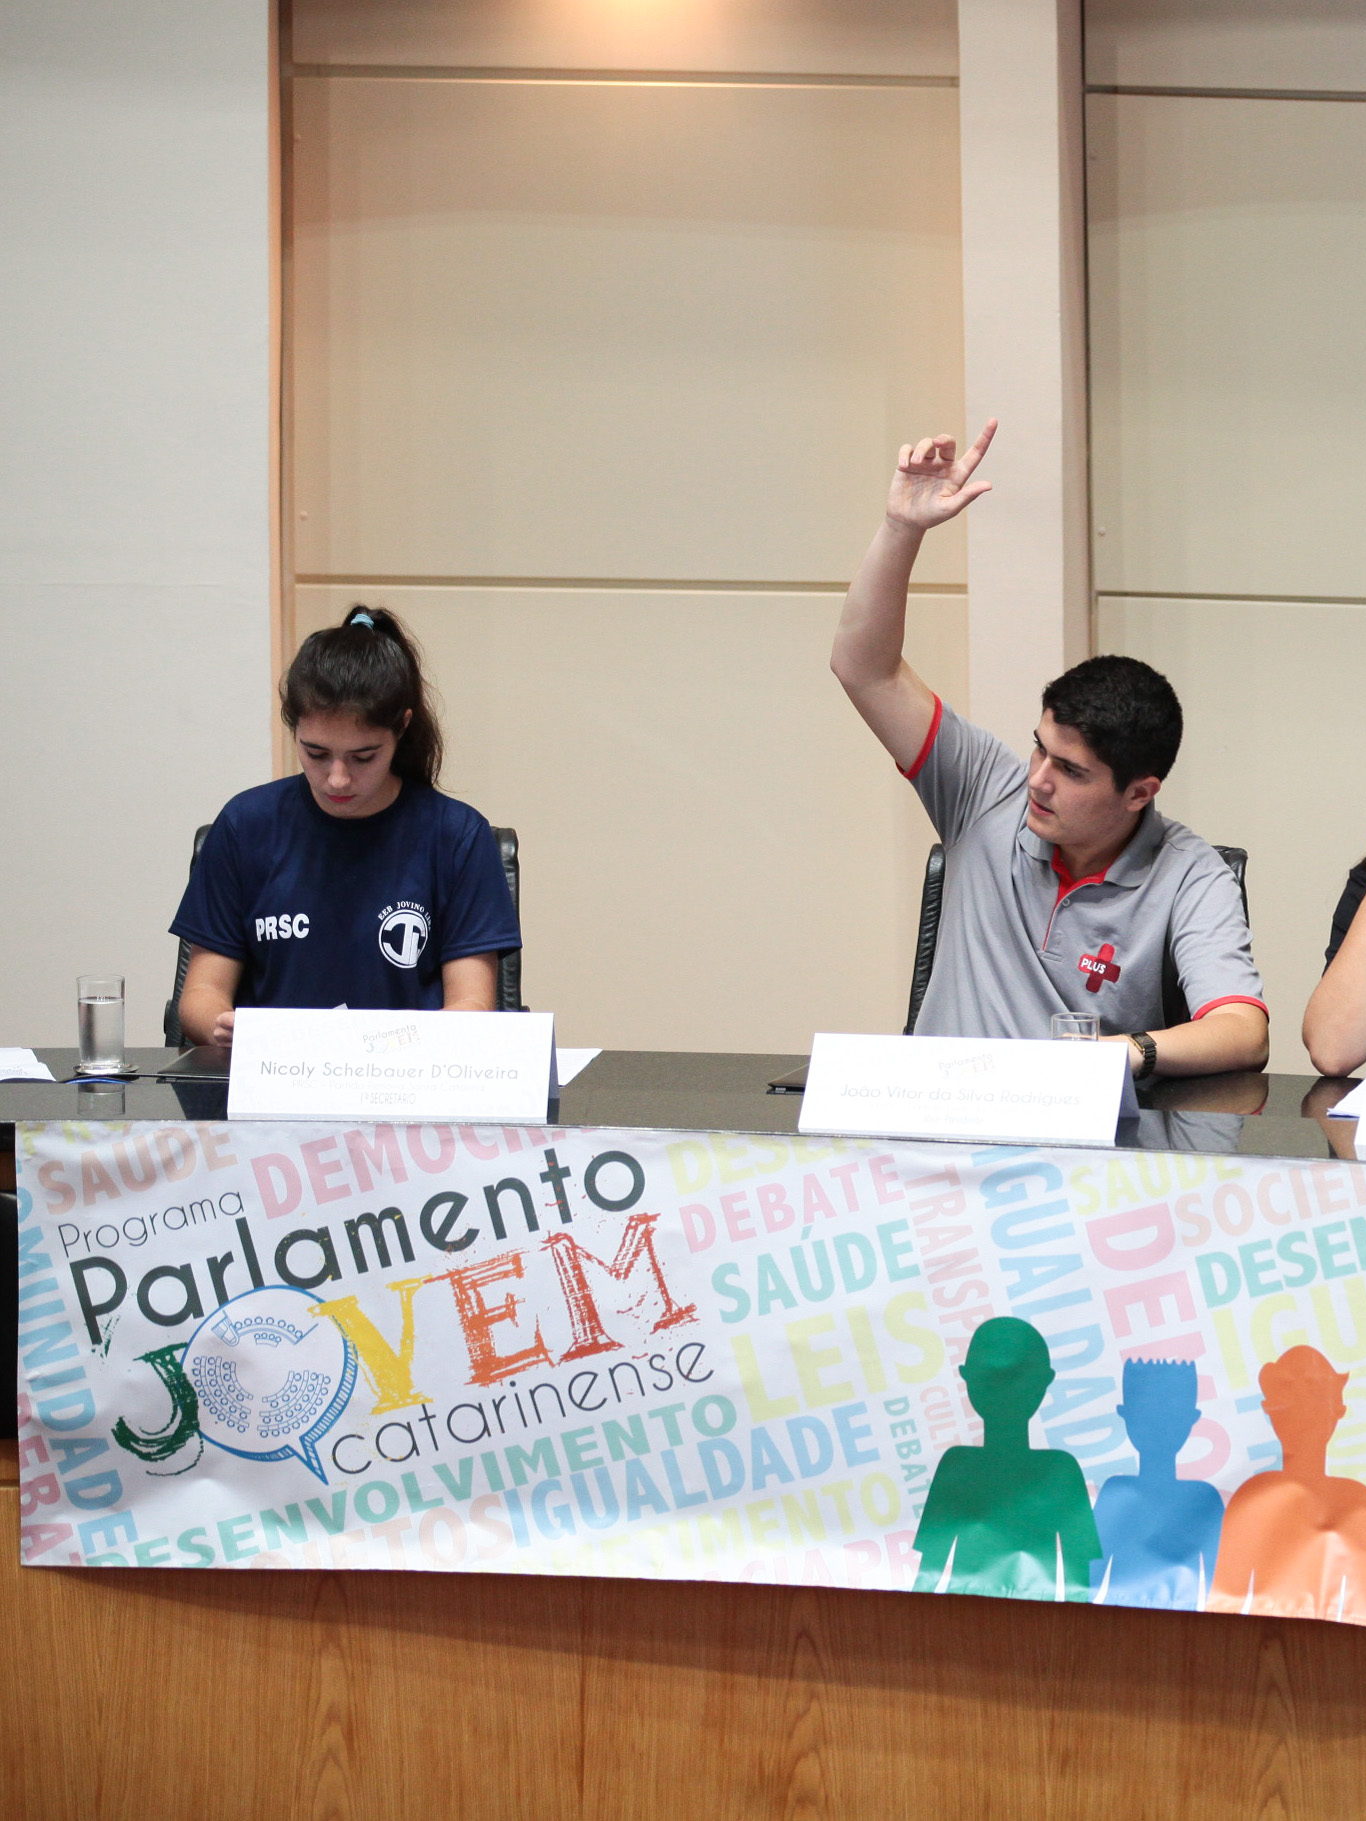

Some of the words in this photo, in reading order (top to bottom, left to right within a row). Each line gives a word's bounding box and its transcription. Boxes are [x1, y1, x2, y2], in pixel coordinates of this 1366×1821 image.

[256, 913, 309, 941] PRSC
[397, 901, 425, 913] JOVINO
[1081, 958, 1106, 974] PLUS
[260, 1060, 315, 1077] Nicoly
[322, 1061, 424, 1079] Schelbauer
[431, 1063, 519, 1080] D'Oliveira
[362, 1024, 417, 1043] Parlamento
[840, 1084, 881, 1098] João
[887, 1086, 923, 1100] Vitor
[929, 1087, 951, 1101] da
[957, 1088, 995, 1102] Silva
[1001, 1090, 1080, 1106] Rodrigues
[58, 1191, 244, 1258] Programa
[70, 1148, 646, 1347] Parlamento
[679, 1153, 905, 1255] DEBATE
[711, 1218, 921, 1324] SAÚDE
[111, 1212, 702, 1486] JOVEM
[730, 1291, 945, 1424] LEIS
[332, 1342, 714, 1475] catarinense
[85, 1394, 738, 1568] ESENVOLVIMENTO
[502, 1401, 880, 1548] IGUALDADE
